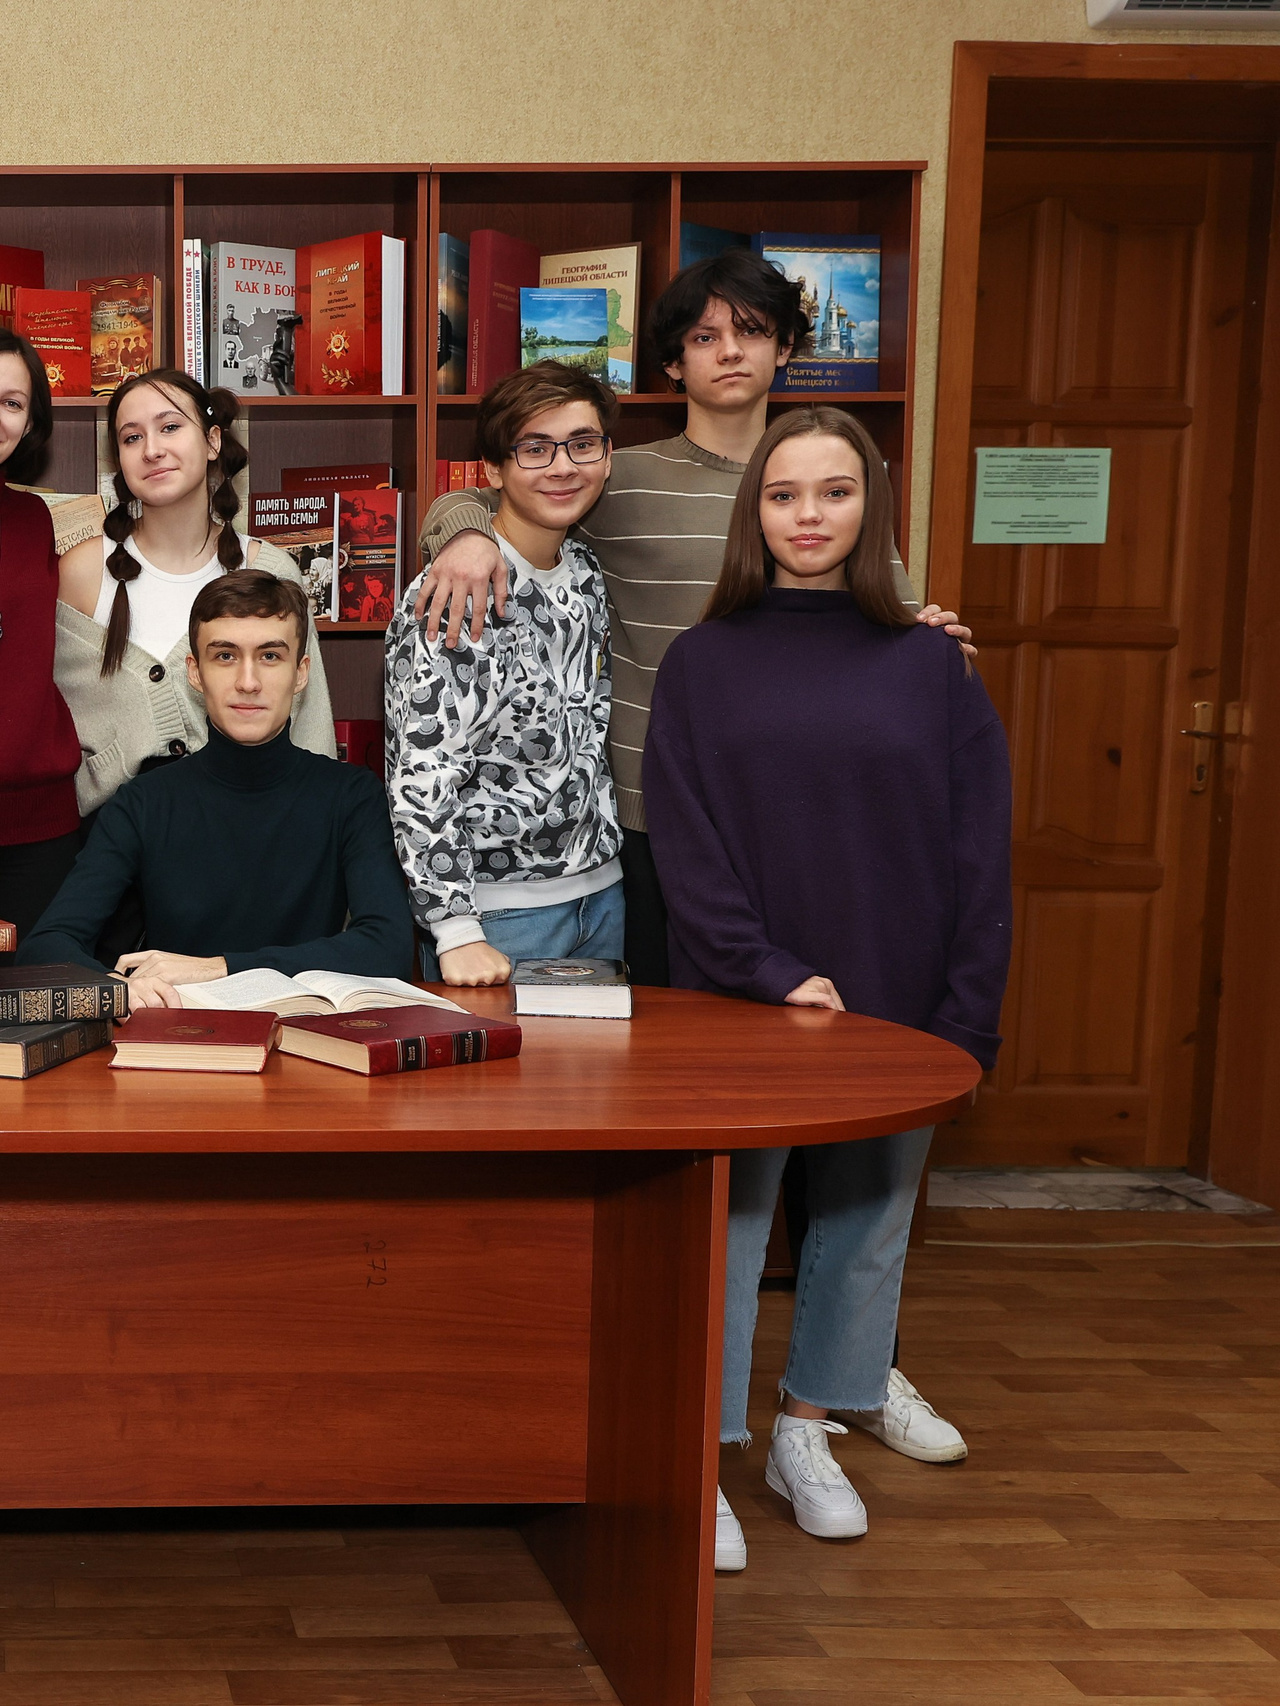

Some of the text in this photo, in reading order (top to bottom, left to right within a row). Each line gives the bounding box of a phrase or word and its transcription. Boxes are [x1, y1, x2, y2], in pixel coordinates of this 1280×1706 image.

[227, 256, 286, 275] В ТРУДЕ,
[315, 261, 360, 278] ЛИПЕКИЙ
[561, 263, 607, 275] ГЕОГРАФИЯ
[541, 270, 628, 286] ЛИПЕЦКОЙ ОБЛАСТИ
[235, 280, 260, 294] КАК
[263, 284, 271, 295] В
[327, 296, 349, 304] ВЕЛИКОЙ
[320, 303, 357, 313] ОТЕЧЕСТВЕННОЙ
[96, 320, 138, 331] 1941-1945
[786, 367, 823, 377] Святые
[785, 376, 832, 387] Липецкого
[255, 496, 328, 512] ПАМЯТЬ НАРОДА.
[255, 511, 319, 527] ПАМЯТЬ СЕМЬИ
[56, 524, 95, 549] ДЕТСКАЯ
